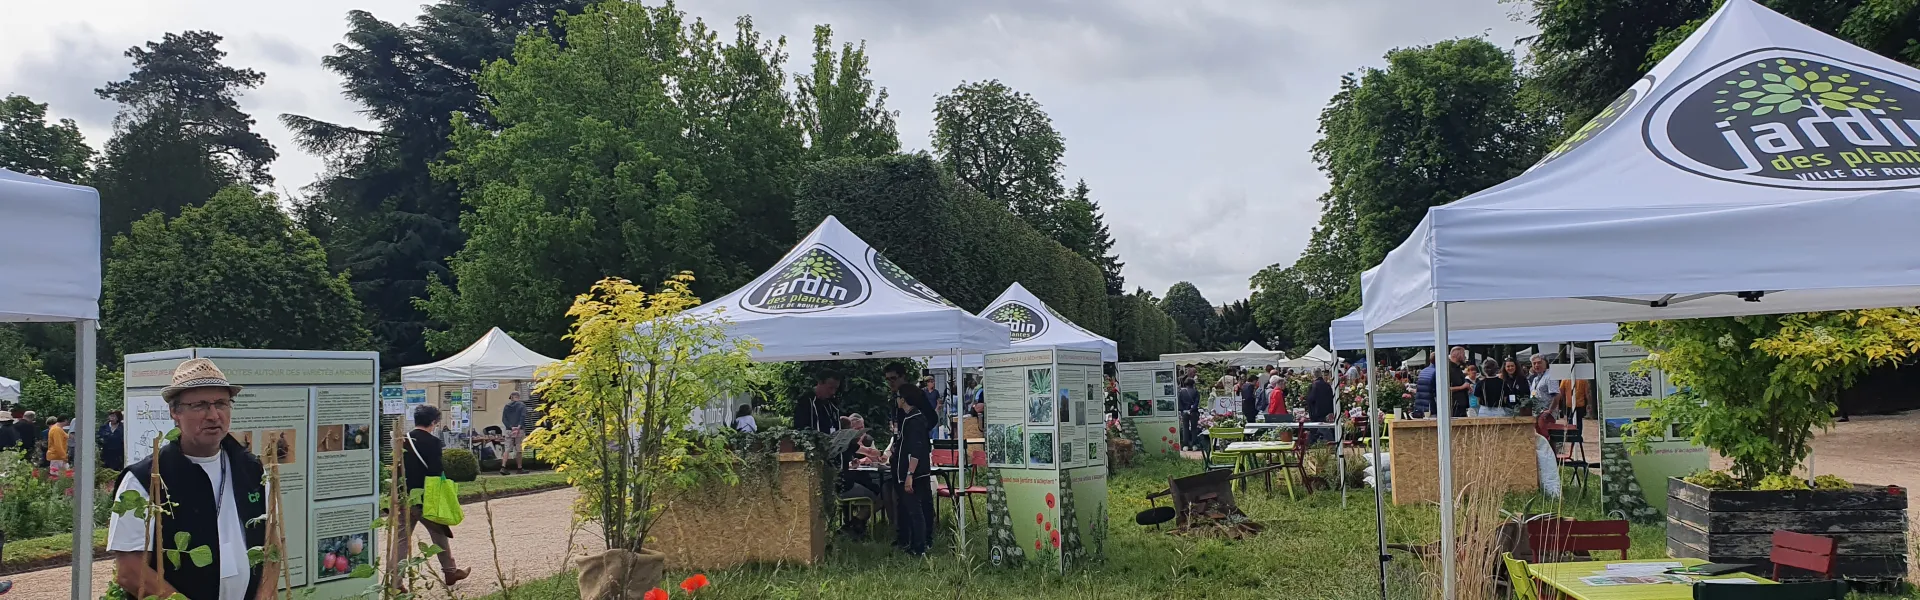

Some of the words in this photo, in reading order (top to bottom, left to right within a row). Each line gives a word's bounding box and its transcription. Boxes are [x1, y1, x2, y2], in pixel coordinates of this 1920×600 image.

[1770, 152, 1833, 171] des
[1839, 148, 1920, 168] plant
[1795, 168, 1848, 181] VILLE
[1851, 166, 1878, 178] DE
[1881, 166, 1920, 177] ROU
[751, 275, 848, 307] jardin
[766, 295, 788, 305] des
[790, 293, 836, 306] plantes
[254, 368, 284, 376] AUTOUR
[285, 368, 300, 376] DES
